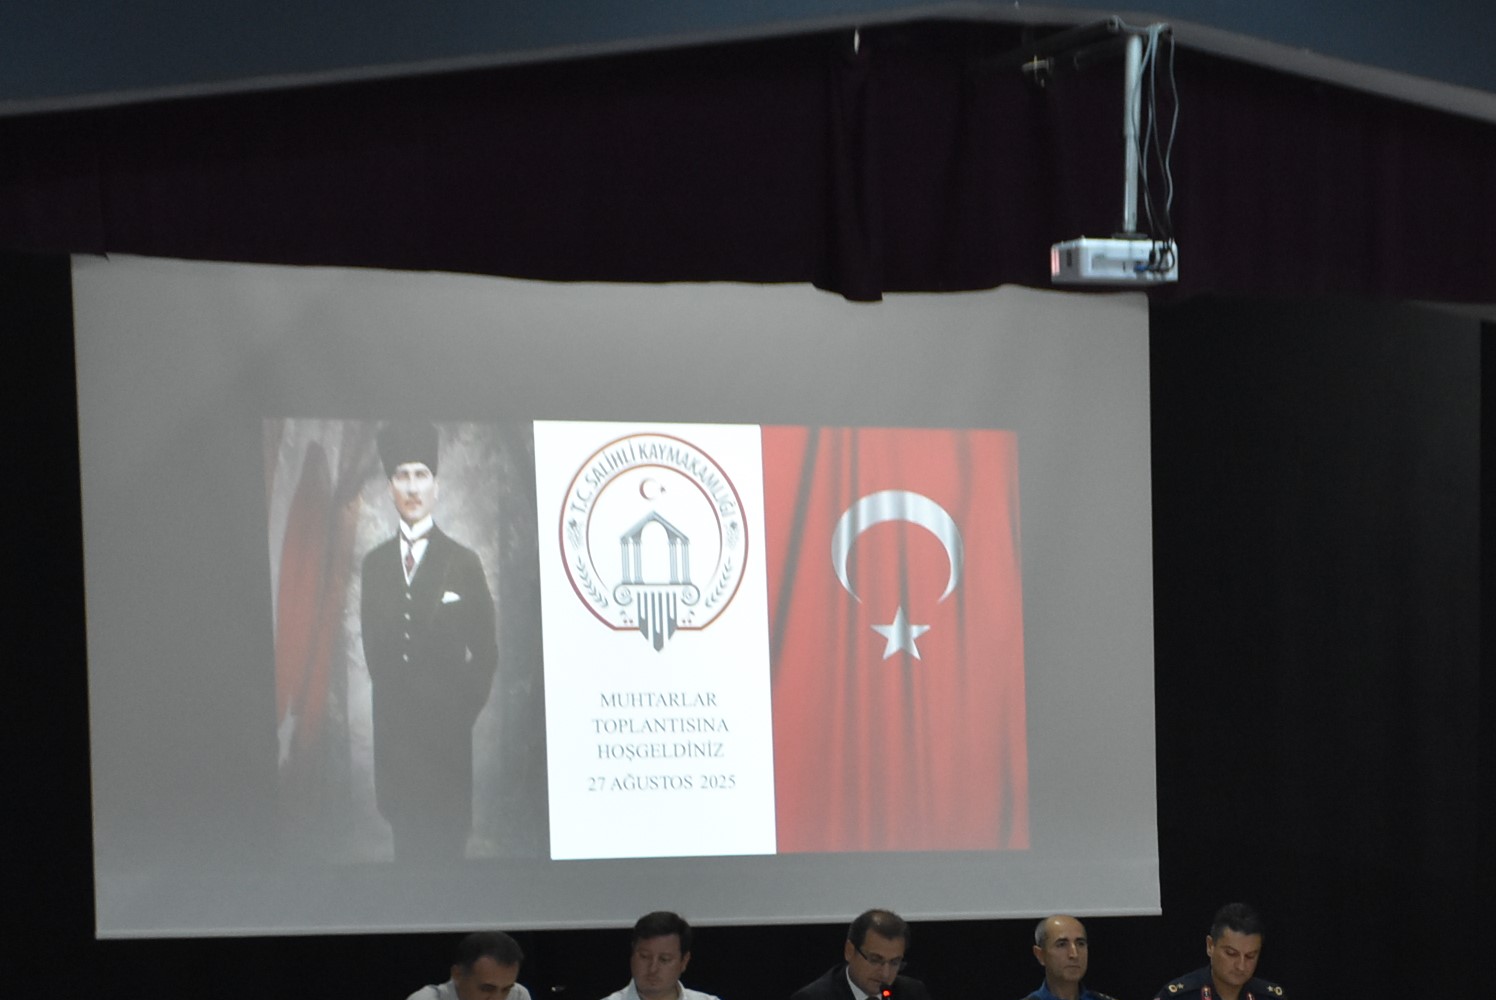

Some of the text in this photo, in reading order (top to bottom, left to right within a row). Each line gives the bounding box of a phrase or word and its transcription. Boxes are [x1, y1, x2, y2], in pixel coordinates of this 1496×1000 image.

[584, 440, 636, 488] SALİHLİ
[600, 692, 717, 708] MUHTARLAR
[592, 717, 729, 734] TOPLANTISINA
[597, 740, 724, 761] HOŞGELDİNİZ
[588, 773, 736, 792] 27 AĞUSTOS 2025
